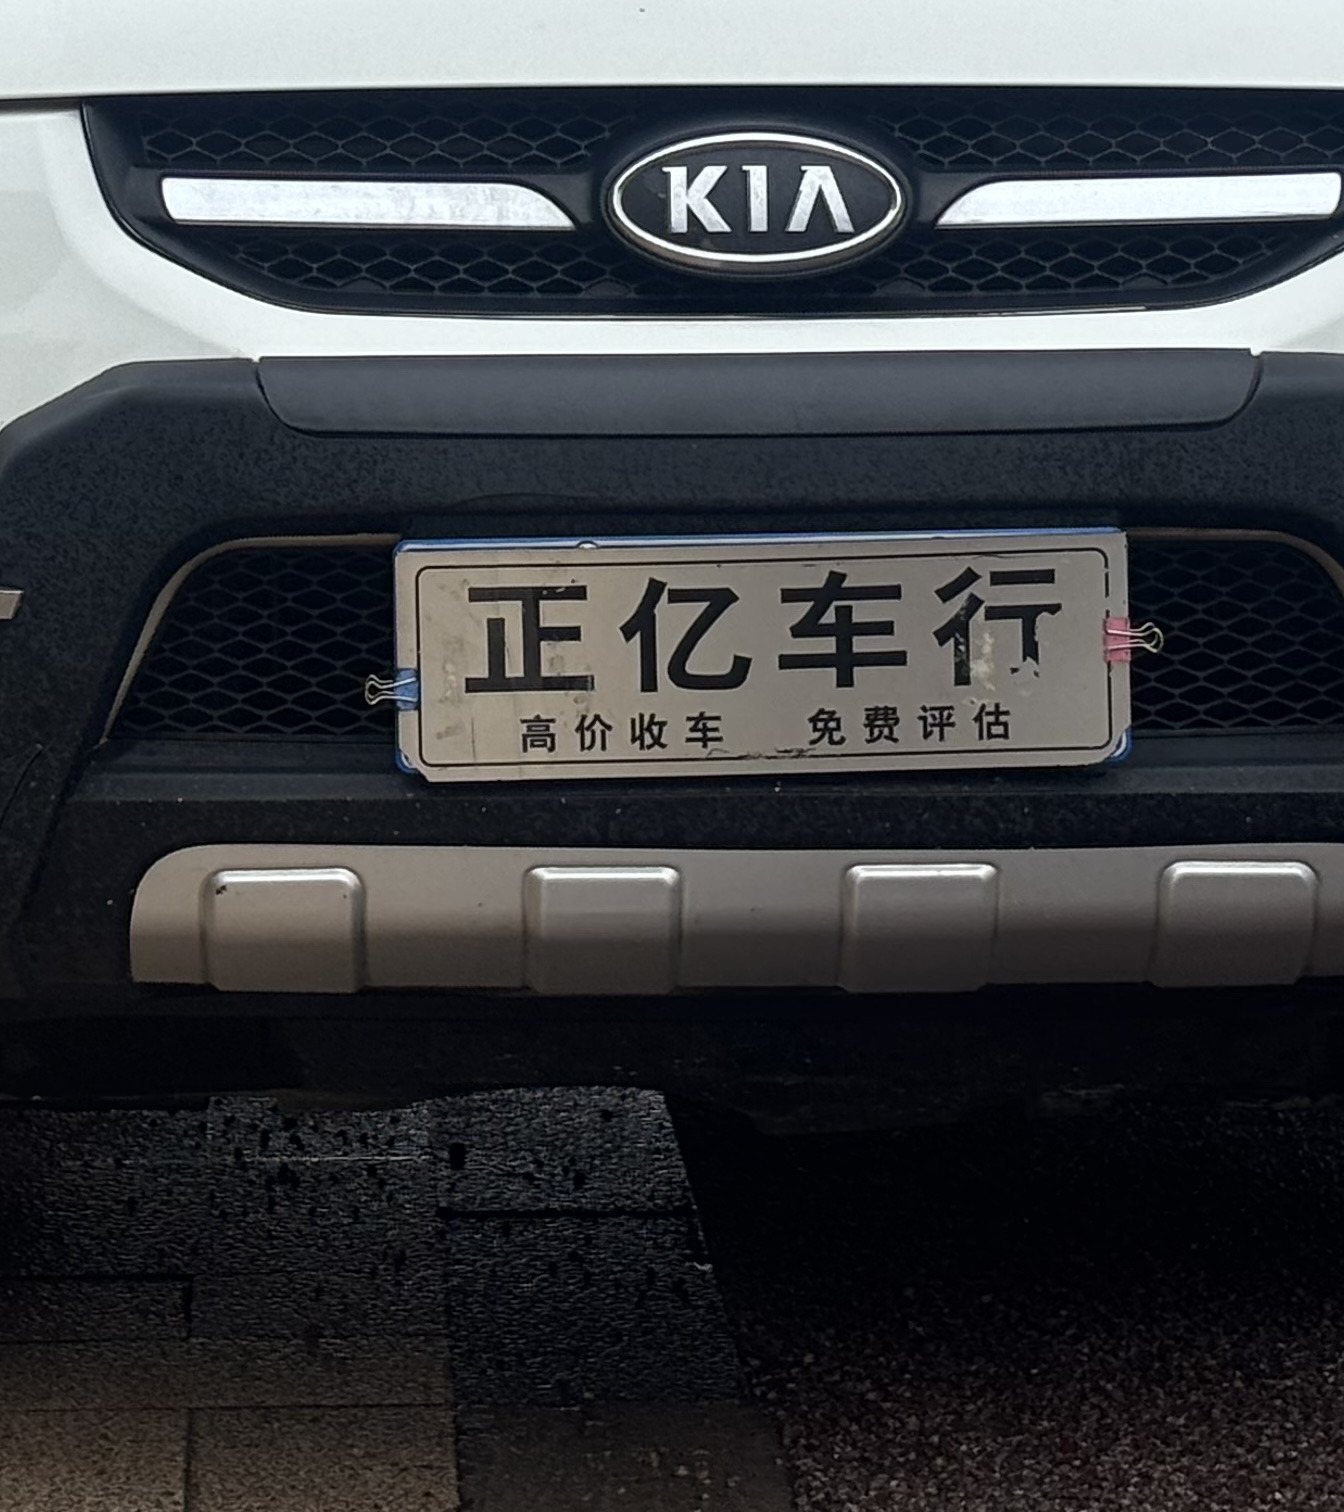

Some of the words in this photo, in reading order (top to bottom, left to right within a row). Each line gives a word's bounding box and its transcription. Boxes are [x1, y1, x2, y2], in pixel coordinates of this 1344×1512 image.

[662, 165, 854, 233] KIA
[465, 568, 1062, 693] 正亿车行
[520, 713, 725, 753] 高价收车
[808, 703, 1012, 746] 免费评估
